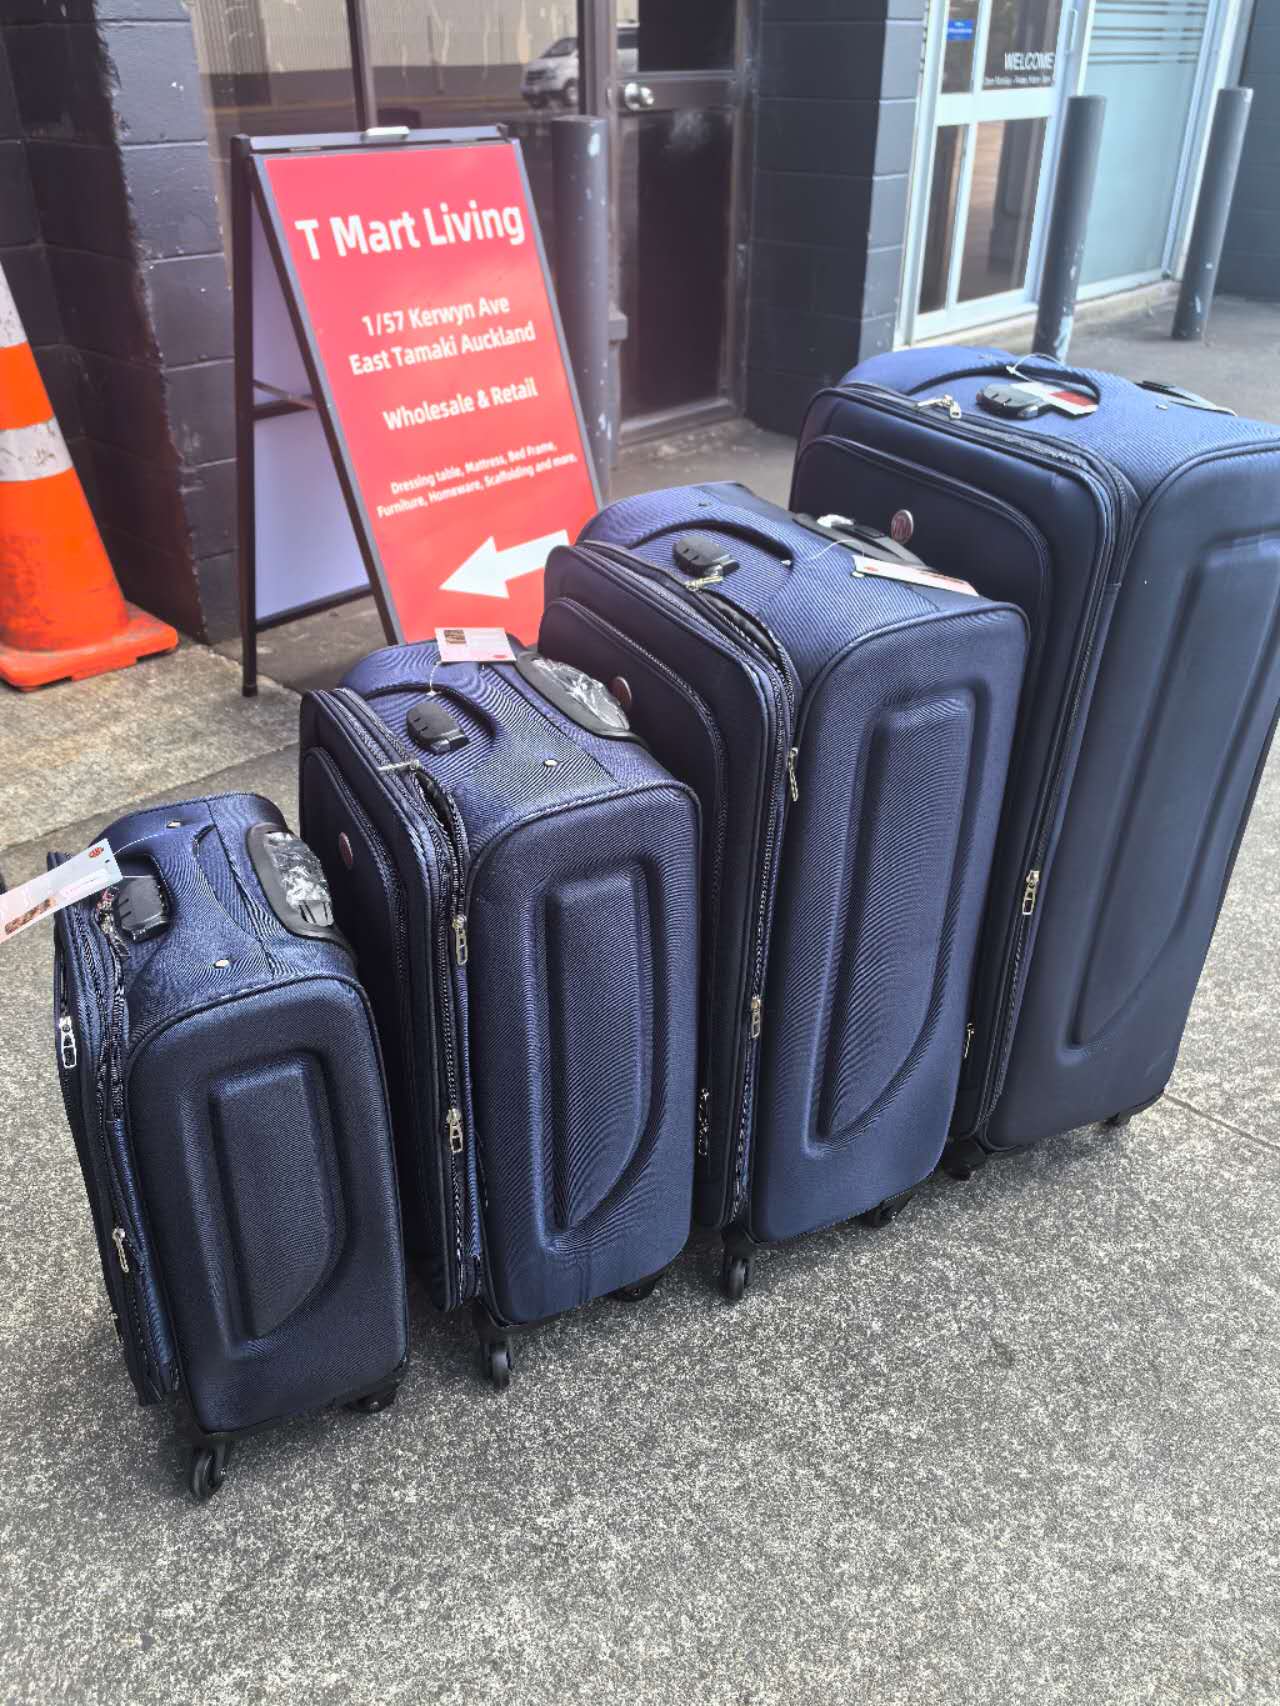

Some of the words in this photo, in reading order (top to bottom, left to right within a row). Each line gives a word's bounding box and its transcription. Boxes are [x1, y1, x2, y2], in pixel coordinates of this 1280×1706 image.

[1004, 52, 1056, 71] WELCOME
[294, 219, 320, 260] T
[329, 211, 421, 257] Mart
[423, 199, 525, 246] Living
[362, 310, 404, 336] 1/57
[408, 302, 476, 327] Kerwyn
[479, 297, 510, 317] Ave
[348, 350, 392, 375] East
[391, 335, 459, 367] Tamaki
[461, 320, 536, 354] Auckland
[382, 393, 475, 430] Wholesale
[477, 389, 490, 409] &
[490, 377, 539, 406] Retail
[376, 495, 428, 518] Furniture,
[428, 479, 484, 503] Homeware,
[483, 463, 535, 488] Scaffolding
[535, 457, 553, 473] and
[390, 473, 436, 494] Dressing
[435, 465, 465, 483] table,
[507, 447, 526, 463] Bed
